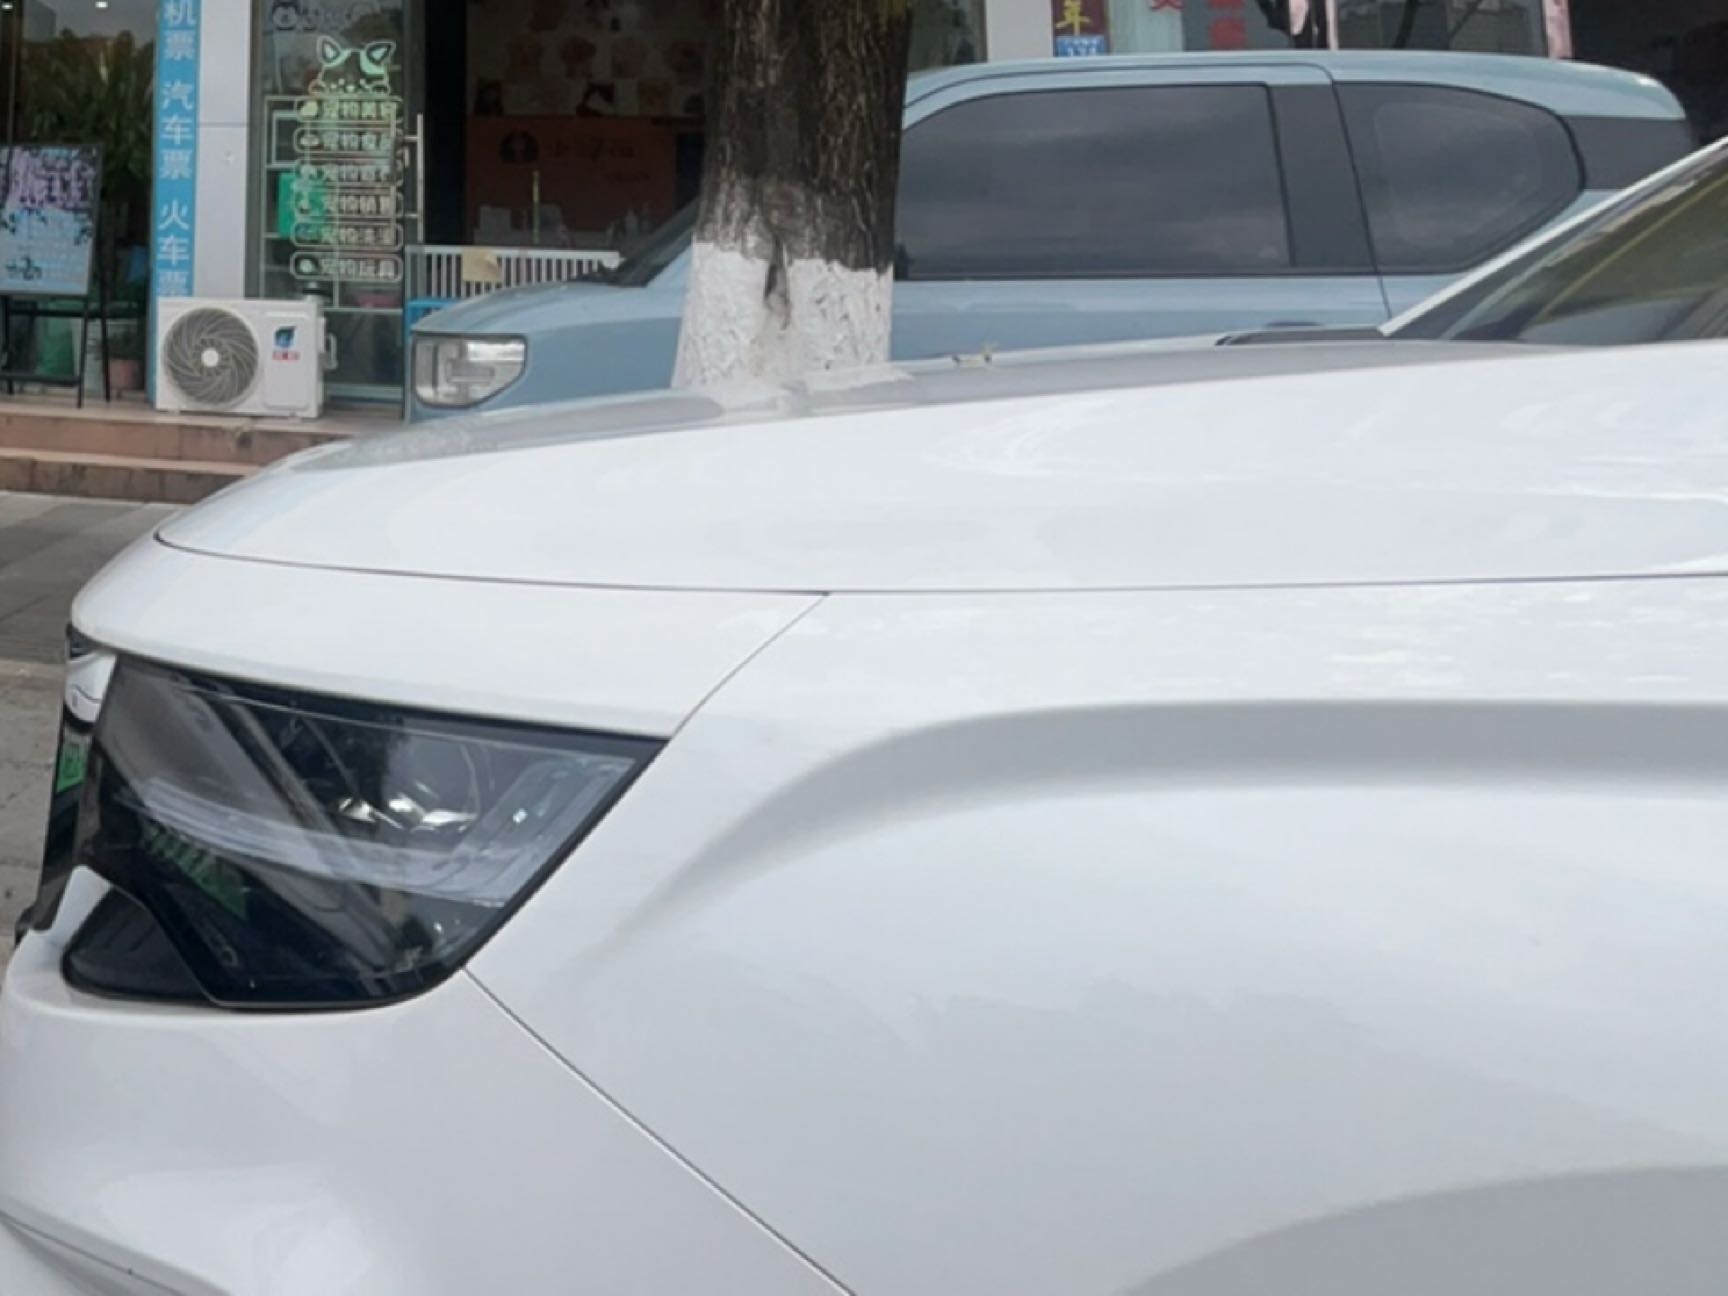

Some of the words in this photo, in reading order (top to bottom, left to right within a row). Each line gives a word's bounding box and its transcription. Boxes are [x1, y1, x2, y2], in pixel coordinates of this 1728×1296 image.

[159, 79, 194, 181] 汽车票
[156, 199, 191, 296] 火车票
